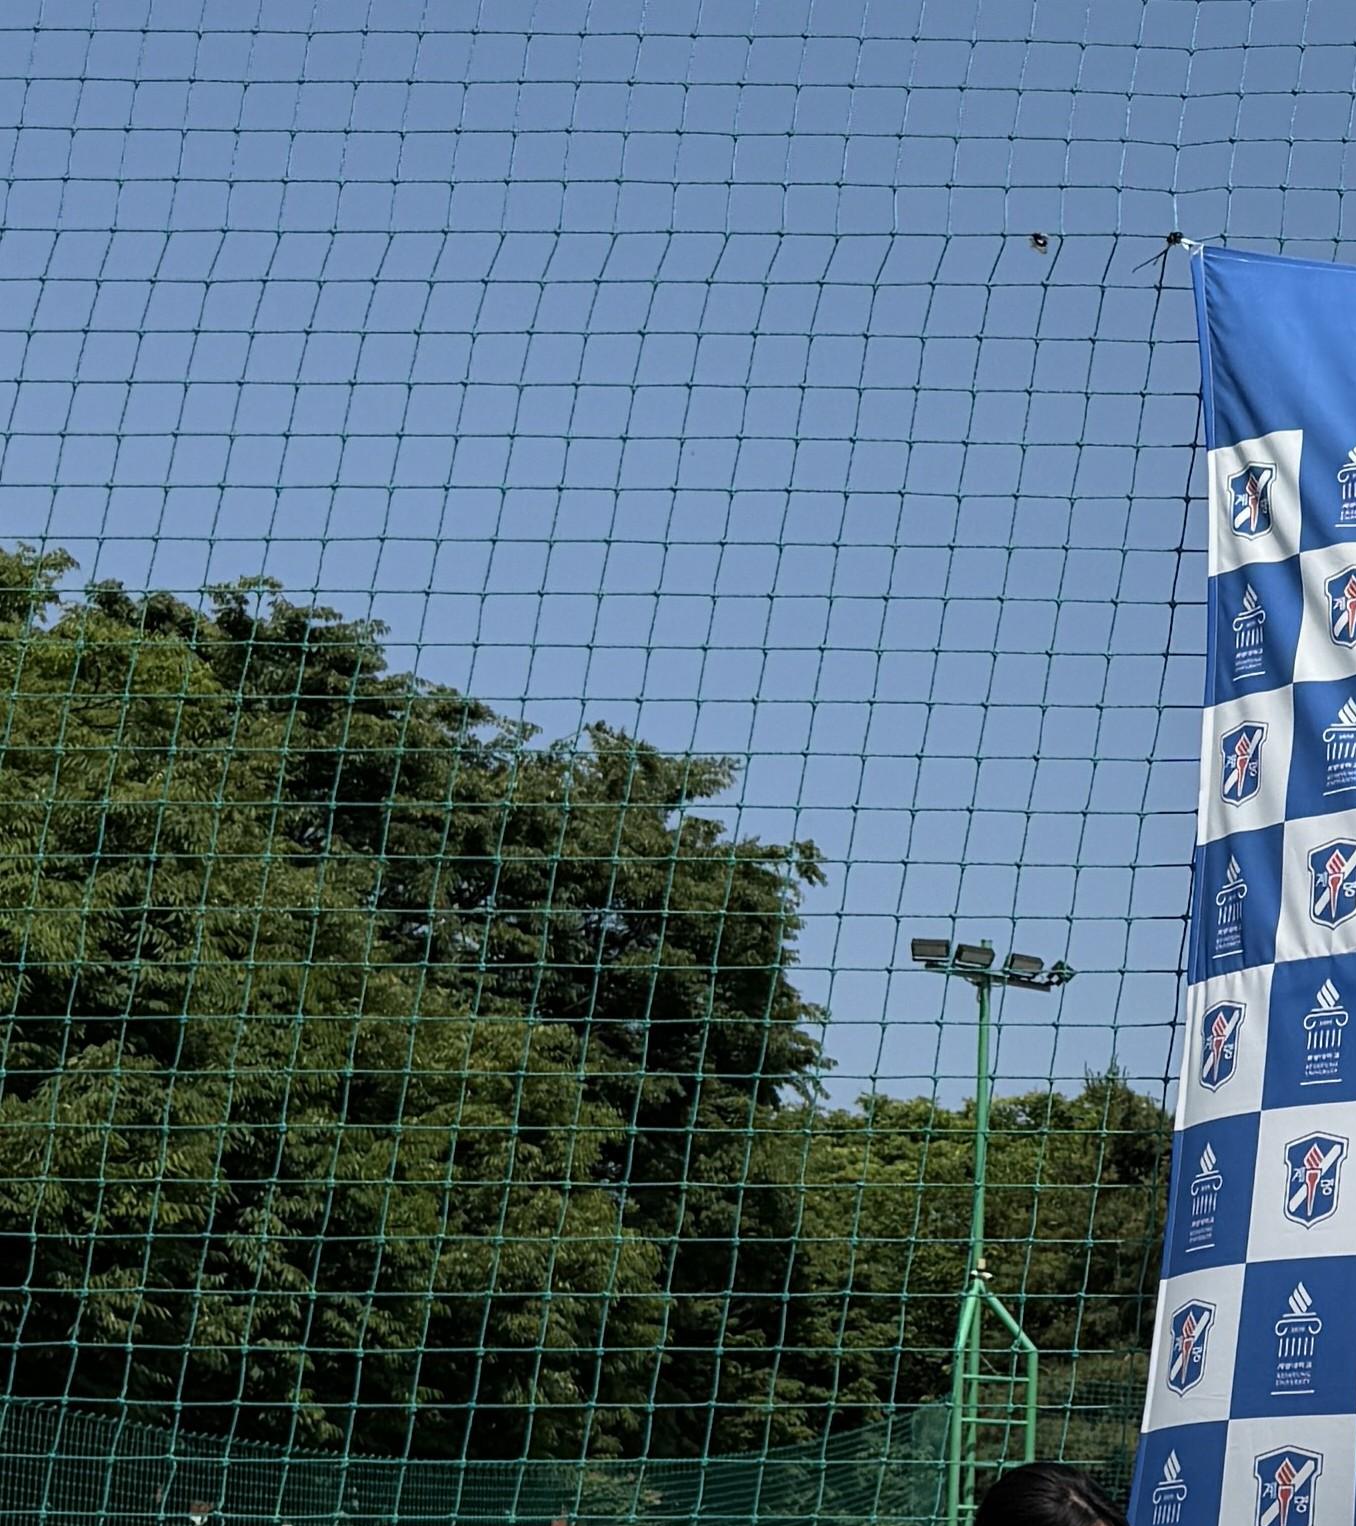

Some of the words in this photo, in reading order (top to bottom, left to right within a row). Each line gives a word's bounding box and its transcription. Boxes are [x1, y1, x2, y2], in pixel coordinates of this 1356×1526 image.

[1316, 872, 1328, 886] 계
[1343, 881, 1356, 896] 명
[1263, 1482, 1277, 1498] 계
[1294, 1496, 1308, 1512] 명
